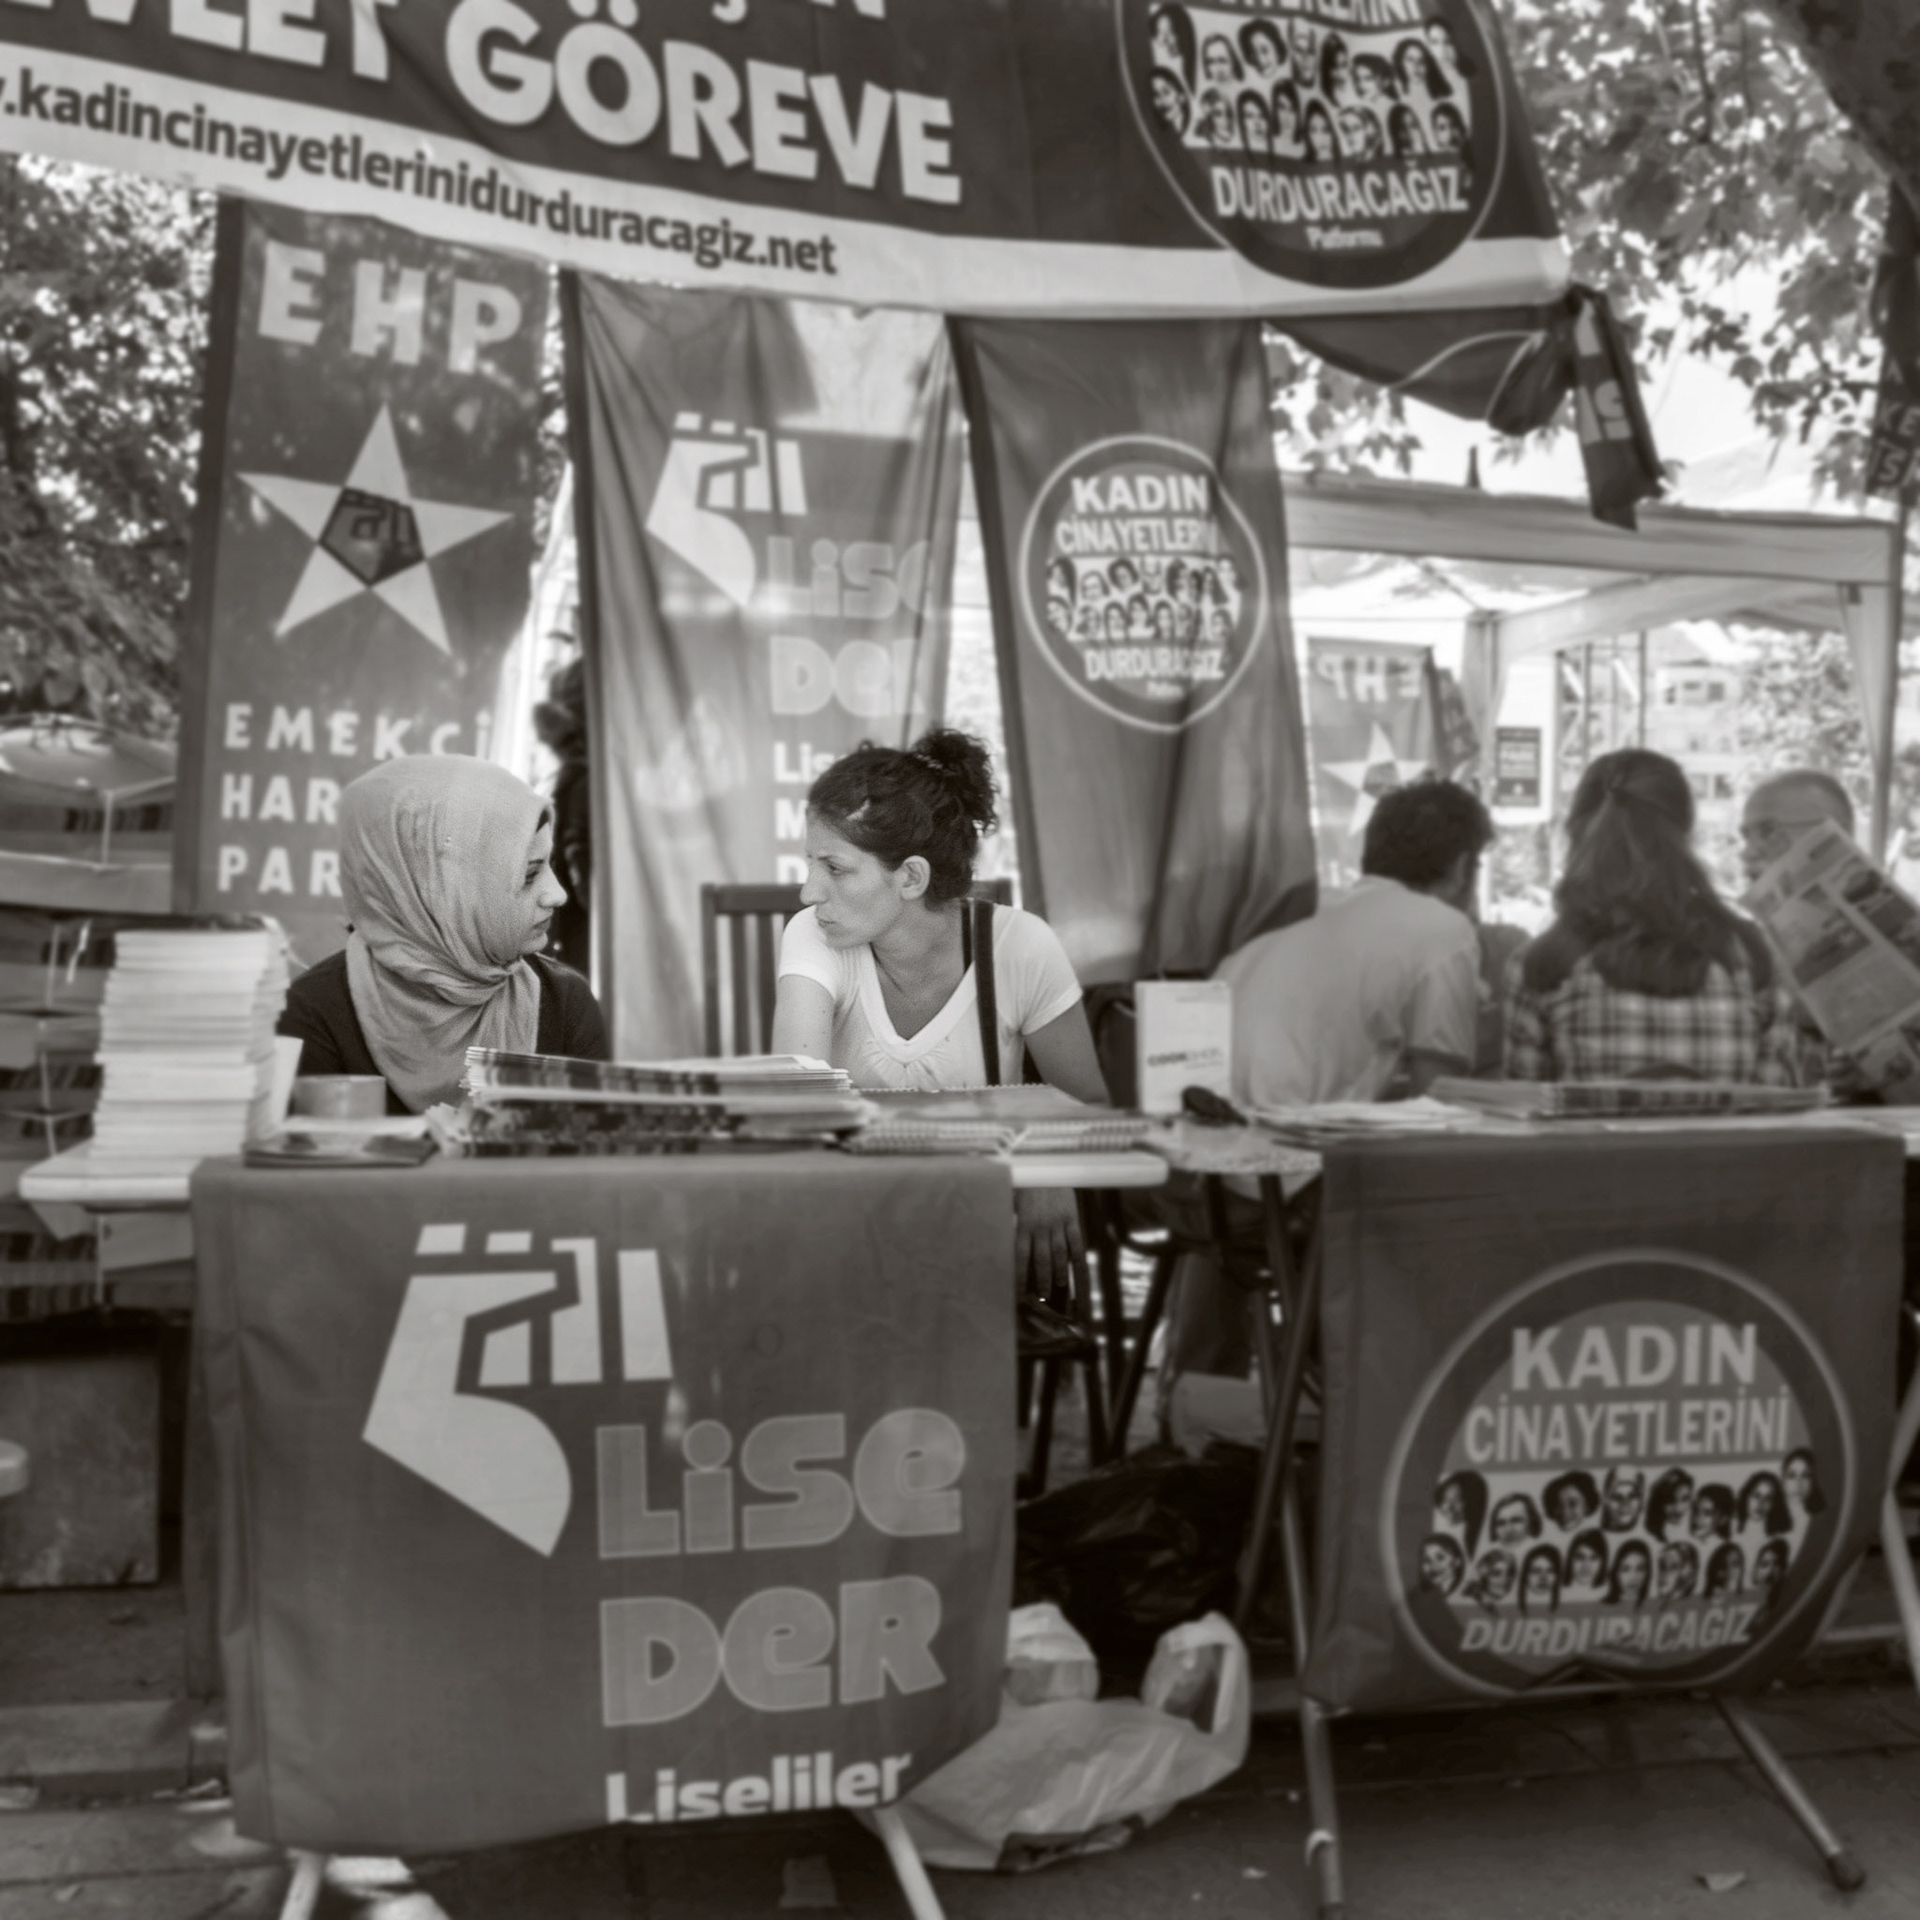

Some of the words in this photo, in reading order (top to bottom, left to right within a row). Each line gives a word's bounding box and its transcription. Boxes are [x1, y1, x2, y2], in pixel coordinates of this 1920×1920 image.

[446, 0, 962, 204] GÖREVE
[0, 66, 838, 275] .kadincinayetlerinidurduracagiz.net
[1211, 159, 1469, 223] DURDURACAĞIZ
[257, 240, 523, 374] EHP
[1072, 475, 1208, 514] KADIN
[221, 774, 342, 825] HAR
[217, 846, 344, 897] PAR
[1511, 1323, 1757, 1391] KADIN
[1464, 1385, 1791, 1463] CİNAYETLERİNİ
[605, 1750, 912, 1823] Liseliler
